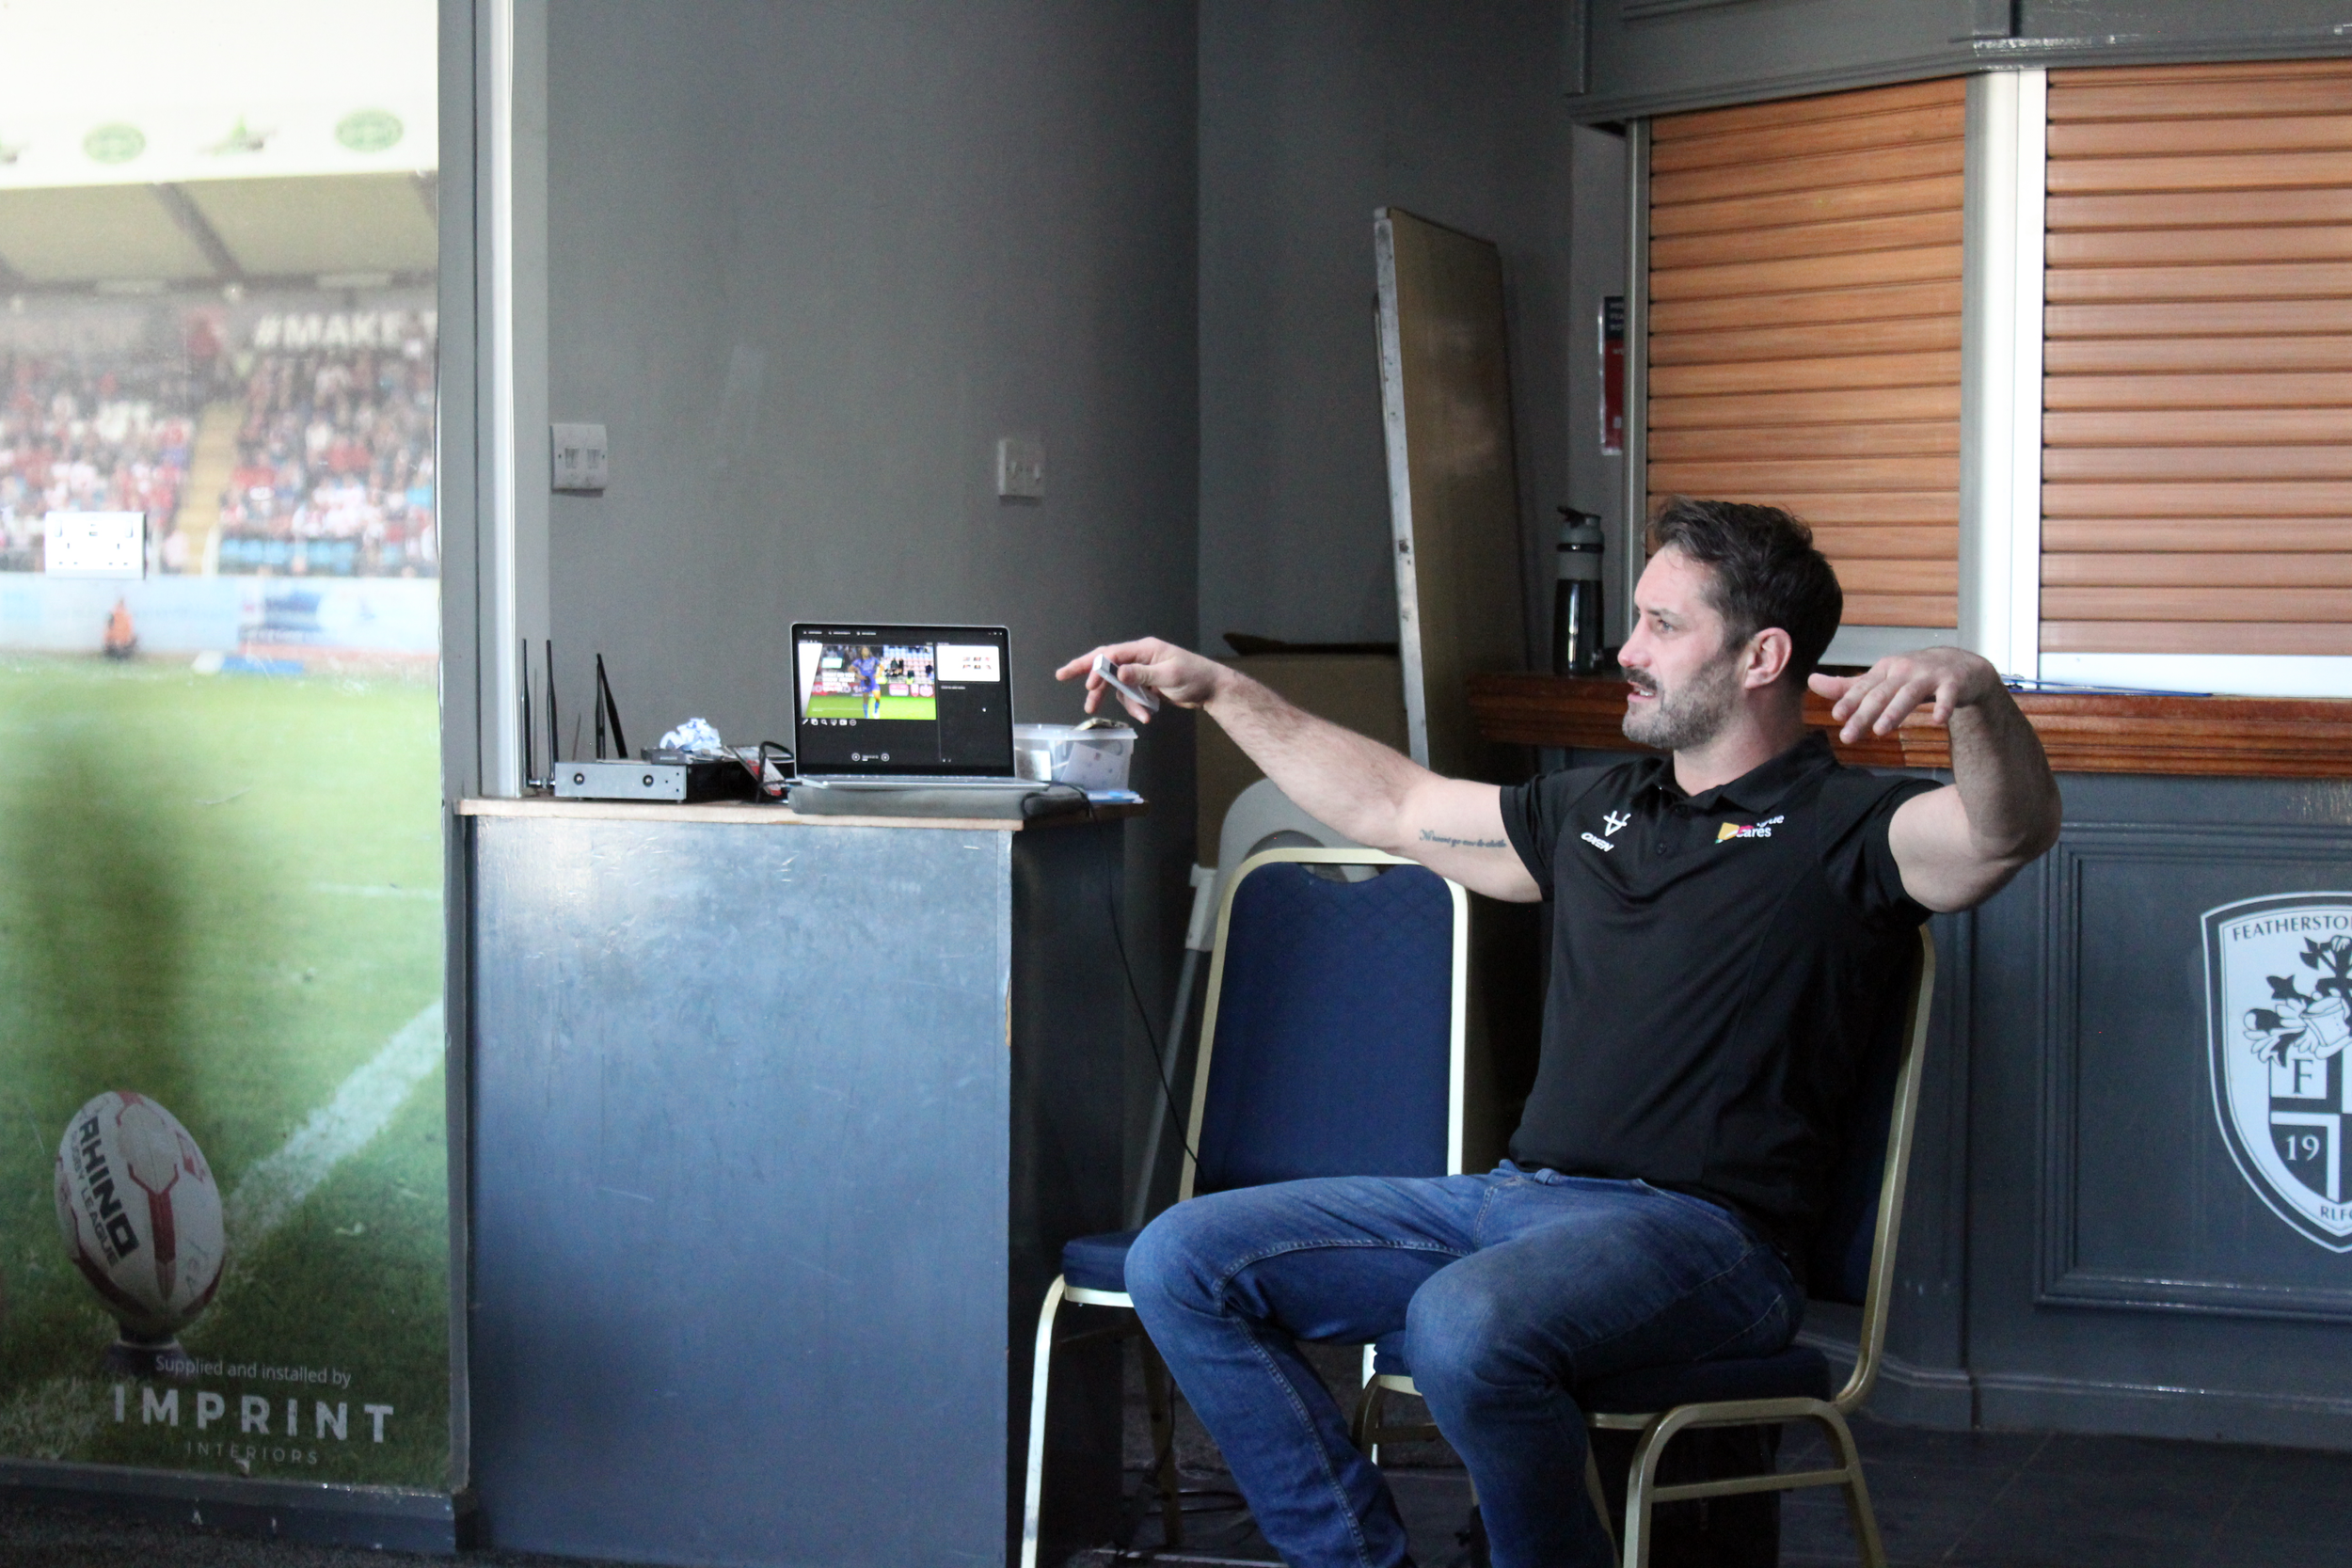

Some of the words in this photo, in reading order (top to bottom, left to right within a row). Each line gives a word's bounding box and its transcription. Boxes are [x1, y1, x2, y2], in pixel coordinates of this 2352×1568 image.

[1581, 832, 1614, 852] OXEN
[2233, 915, 2352, 942] FEATHERSTO
[2292, 1058, 2314, 1094] F
[2286, 1134, 2320, 1161] 19
[78, 1116, 139, 1259] RHINO
[81, 1188, 119, 1268] LEAGUE
[155, 1355, 223, 1378] Supplied
[228, 1362, 257, 1378] and
[262, 1364, 327, 1384] installed
[332, 1369, 352, 1389] by
[114, 1384, 394, 1443] IMPRINT
[188, 1442, 318, 1465] INTERIORS
